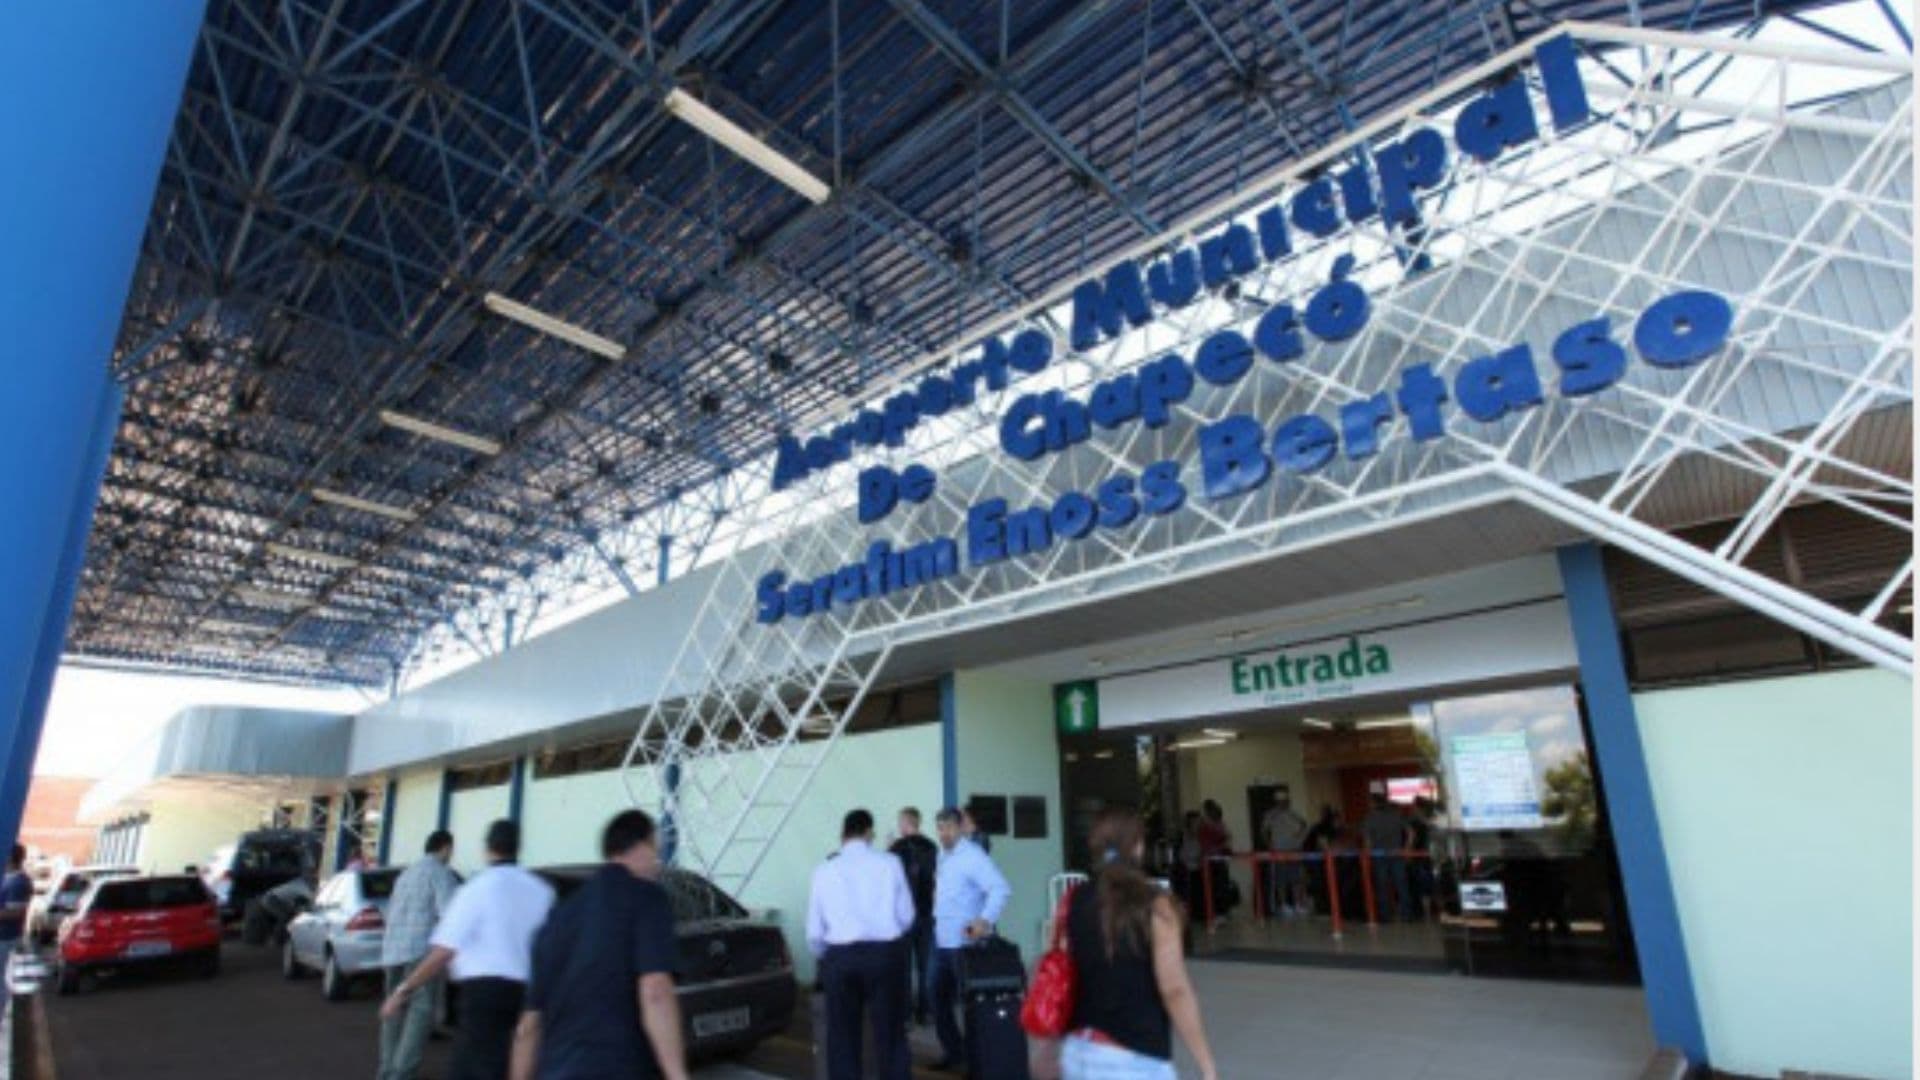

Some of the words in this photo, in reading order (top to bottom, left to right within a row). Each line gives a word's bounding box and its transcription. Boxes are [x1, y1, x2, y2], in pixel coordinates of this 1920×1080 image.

[772, 329, 1053, 491] Aeroporto
[1071, 33, 1591, 351] Municipal
[858, 465, 936, 525] De
[1000, 253, 1371, 460] Chapecó
[756, 537, 959, 624] Serafim
[967, 460, 1188, 566] Enoss
[1201, 290, 1733, 499] Bertaso
[1231, 638, 1391, 695] Entrada
